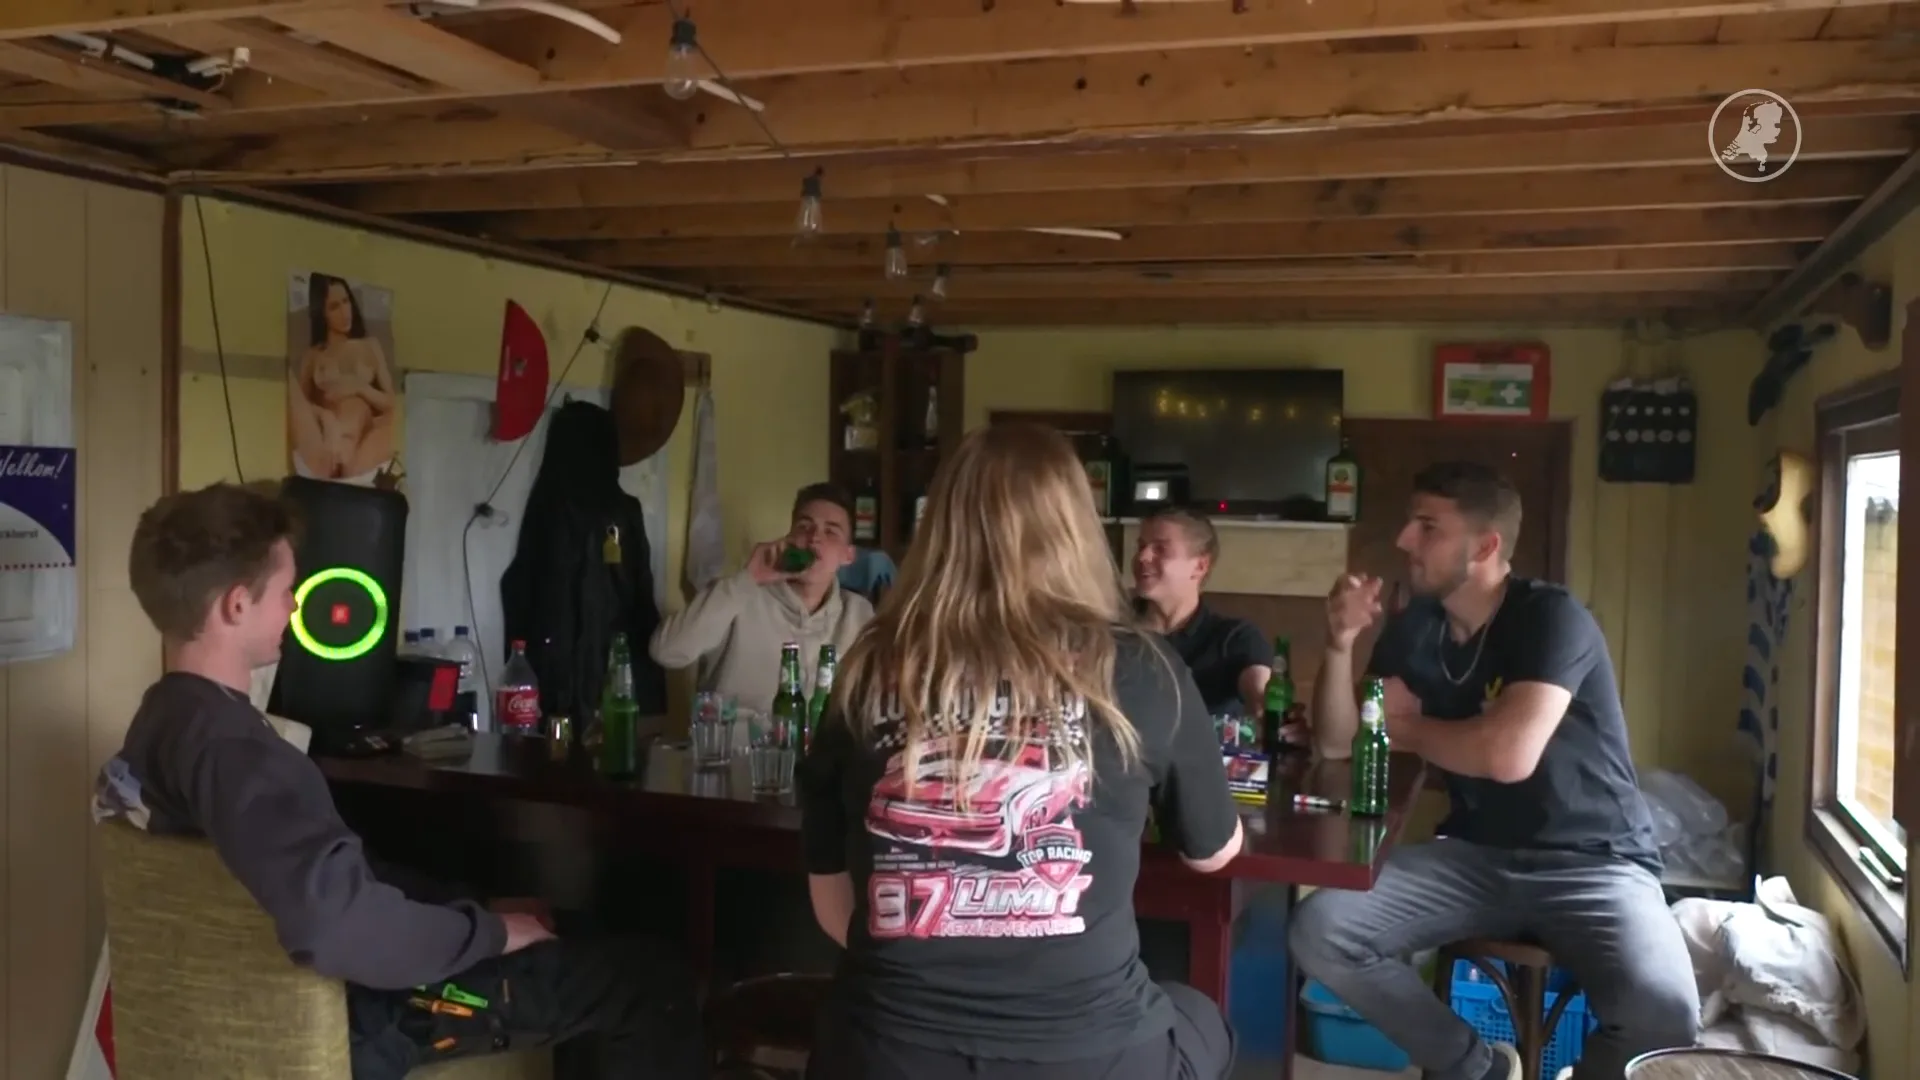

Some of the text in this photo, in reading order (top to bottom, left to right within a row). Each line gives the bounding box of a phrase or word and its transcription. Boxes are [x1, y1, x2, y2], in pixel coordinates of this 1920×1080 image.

[1018, 846, 1093, 866] TOP RACING
[950, 875, 1093, 917] LIMIT
